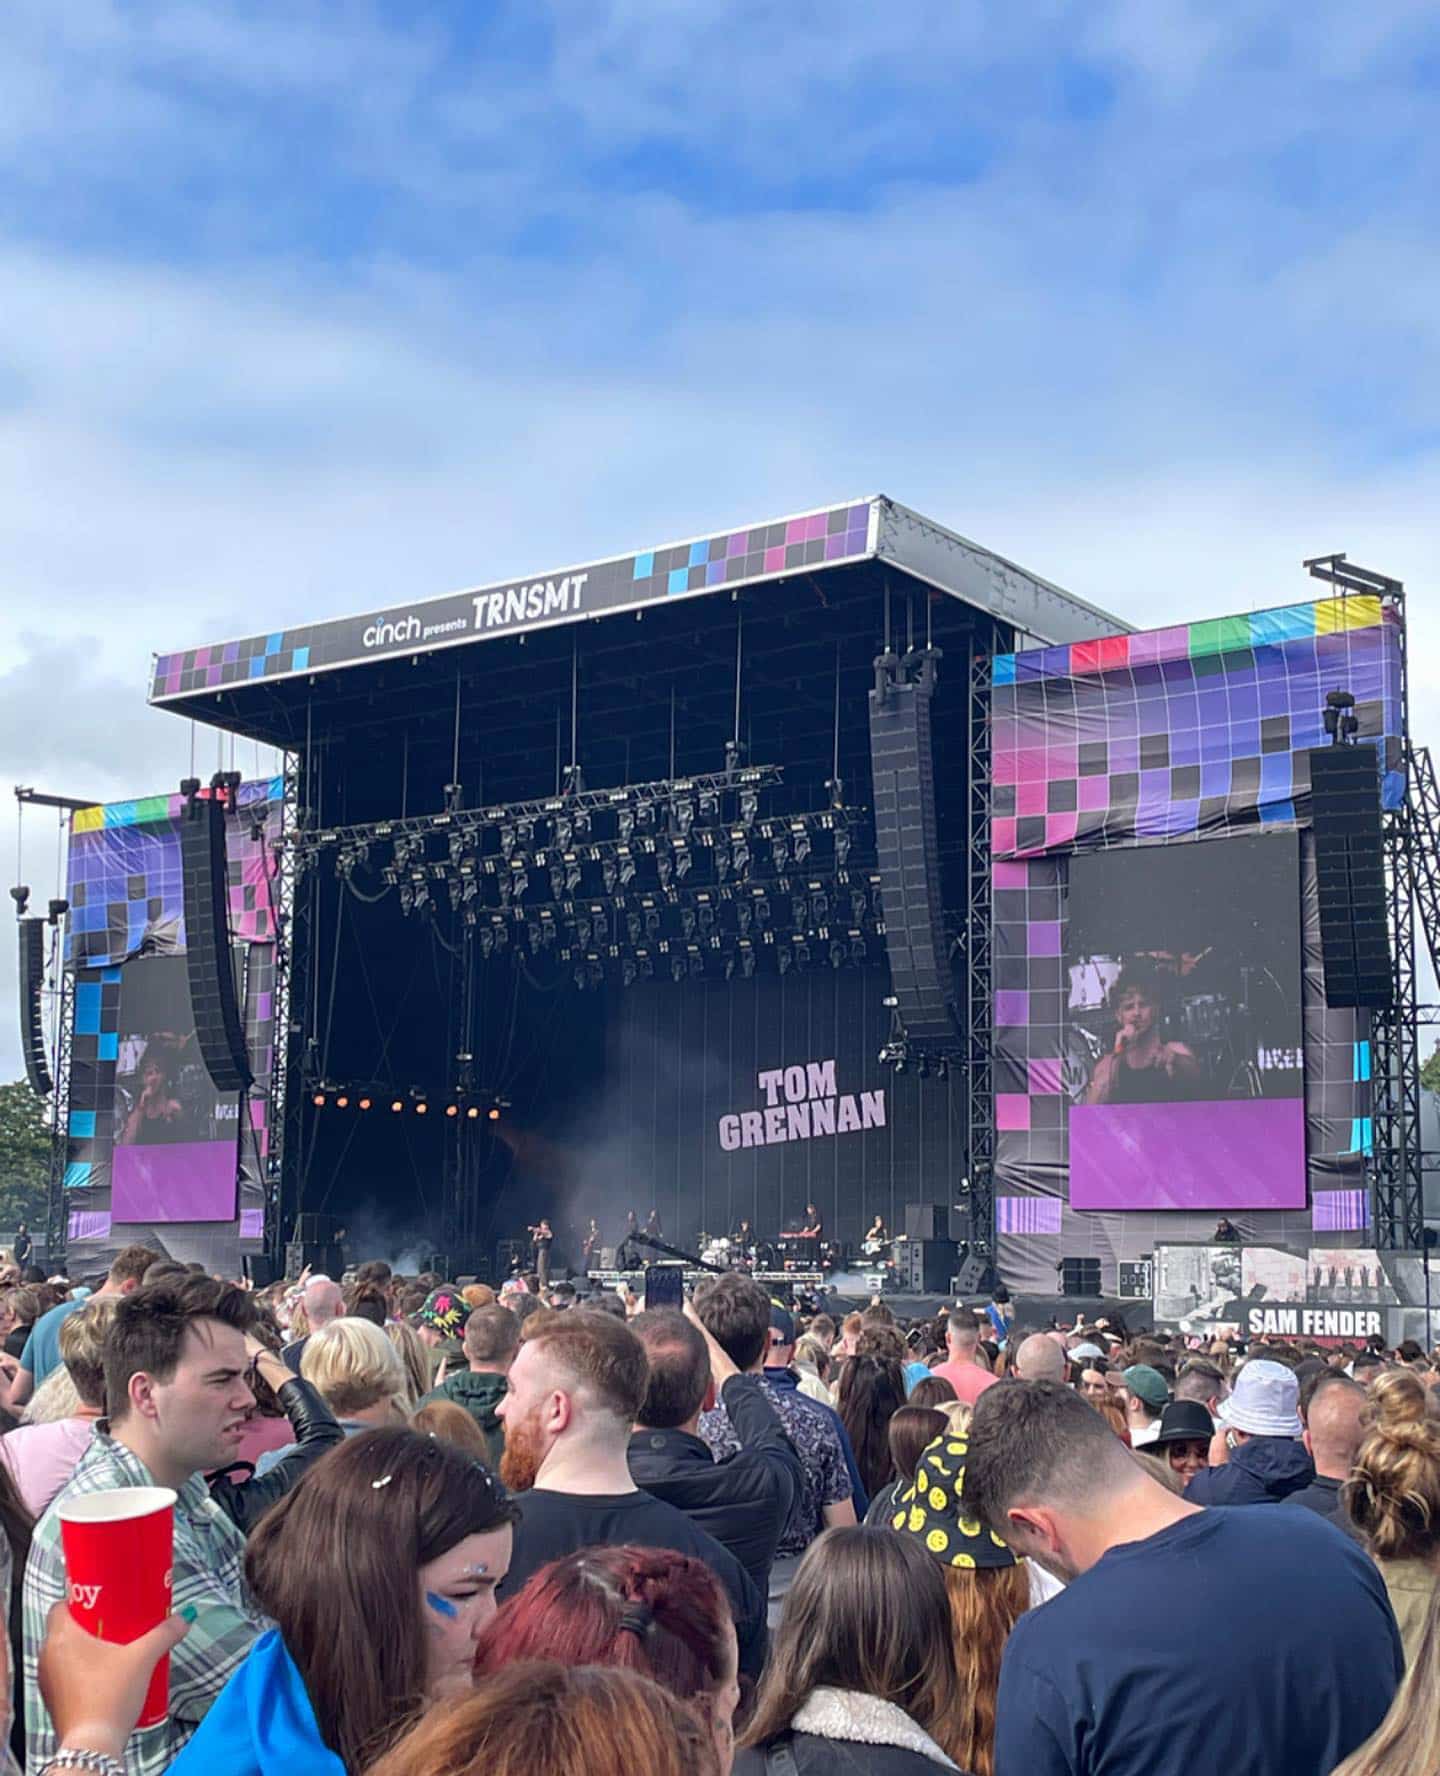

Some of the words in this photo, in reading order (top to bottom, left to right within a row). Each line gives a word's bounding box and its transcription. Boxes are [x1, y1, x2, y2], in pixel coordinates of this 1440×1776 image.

[363, 615, 421, 647] cinch
[423, 618, 467, 640] presents
[472, 573, 588, 629] TRNSMT
[758, 1059, 837, 1107] TOM
[719, 1089, 886, 1151] GRENNAN
[1248, 1308, 1296, 1336] SAM
[1302, 1310, 1381, 1337] FENDER
